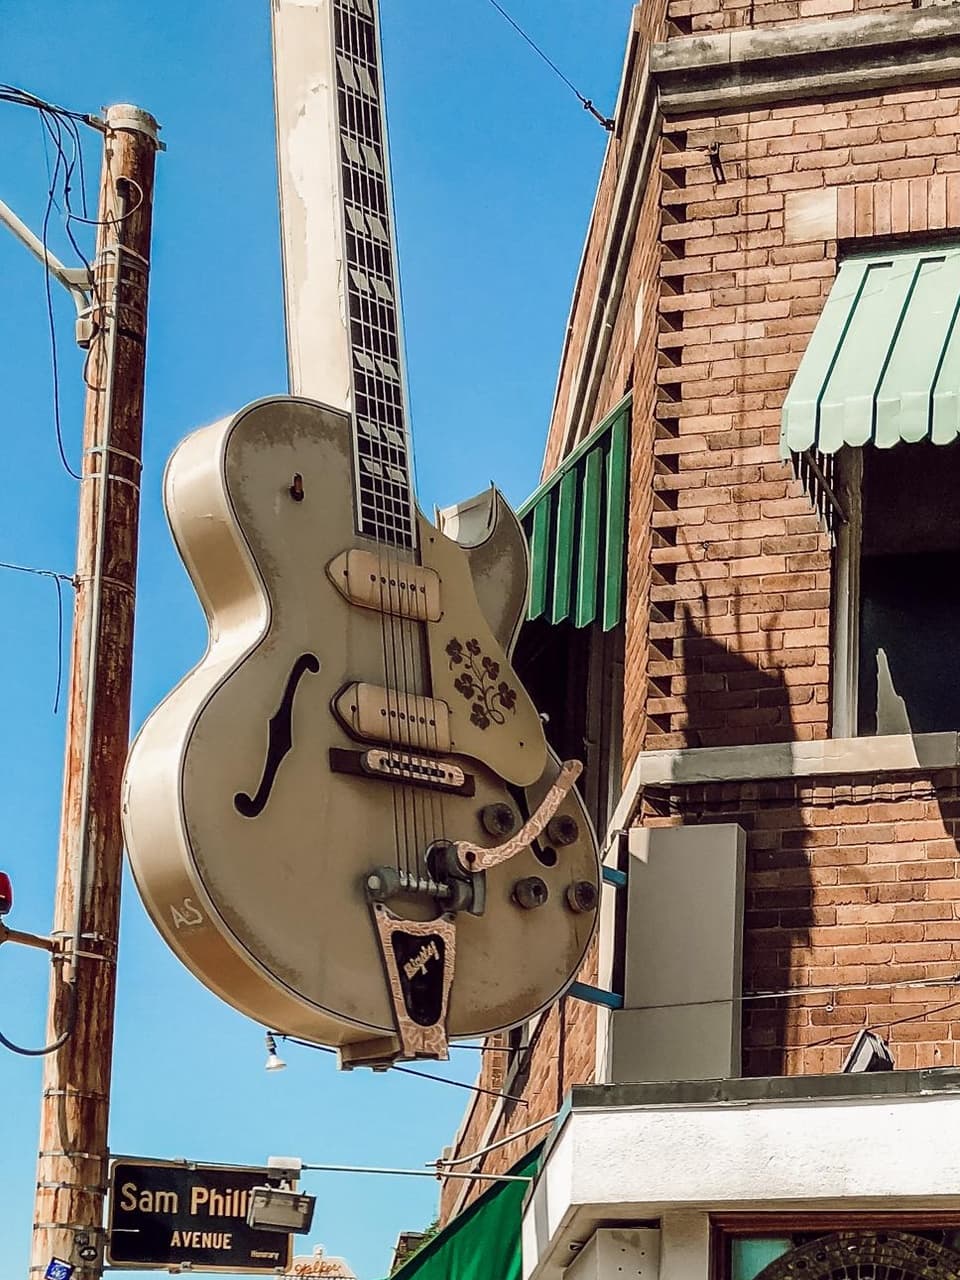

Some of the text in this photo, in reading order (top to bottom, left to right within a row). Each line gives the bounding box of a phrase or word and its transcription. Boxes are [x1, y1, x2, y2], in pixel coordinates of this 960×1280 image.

[120, 1182, 252, 1217] Sam Phill
[170, 1230, 233, 1250] AVENUE
